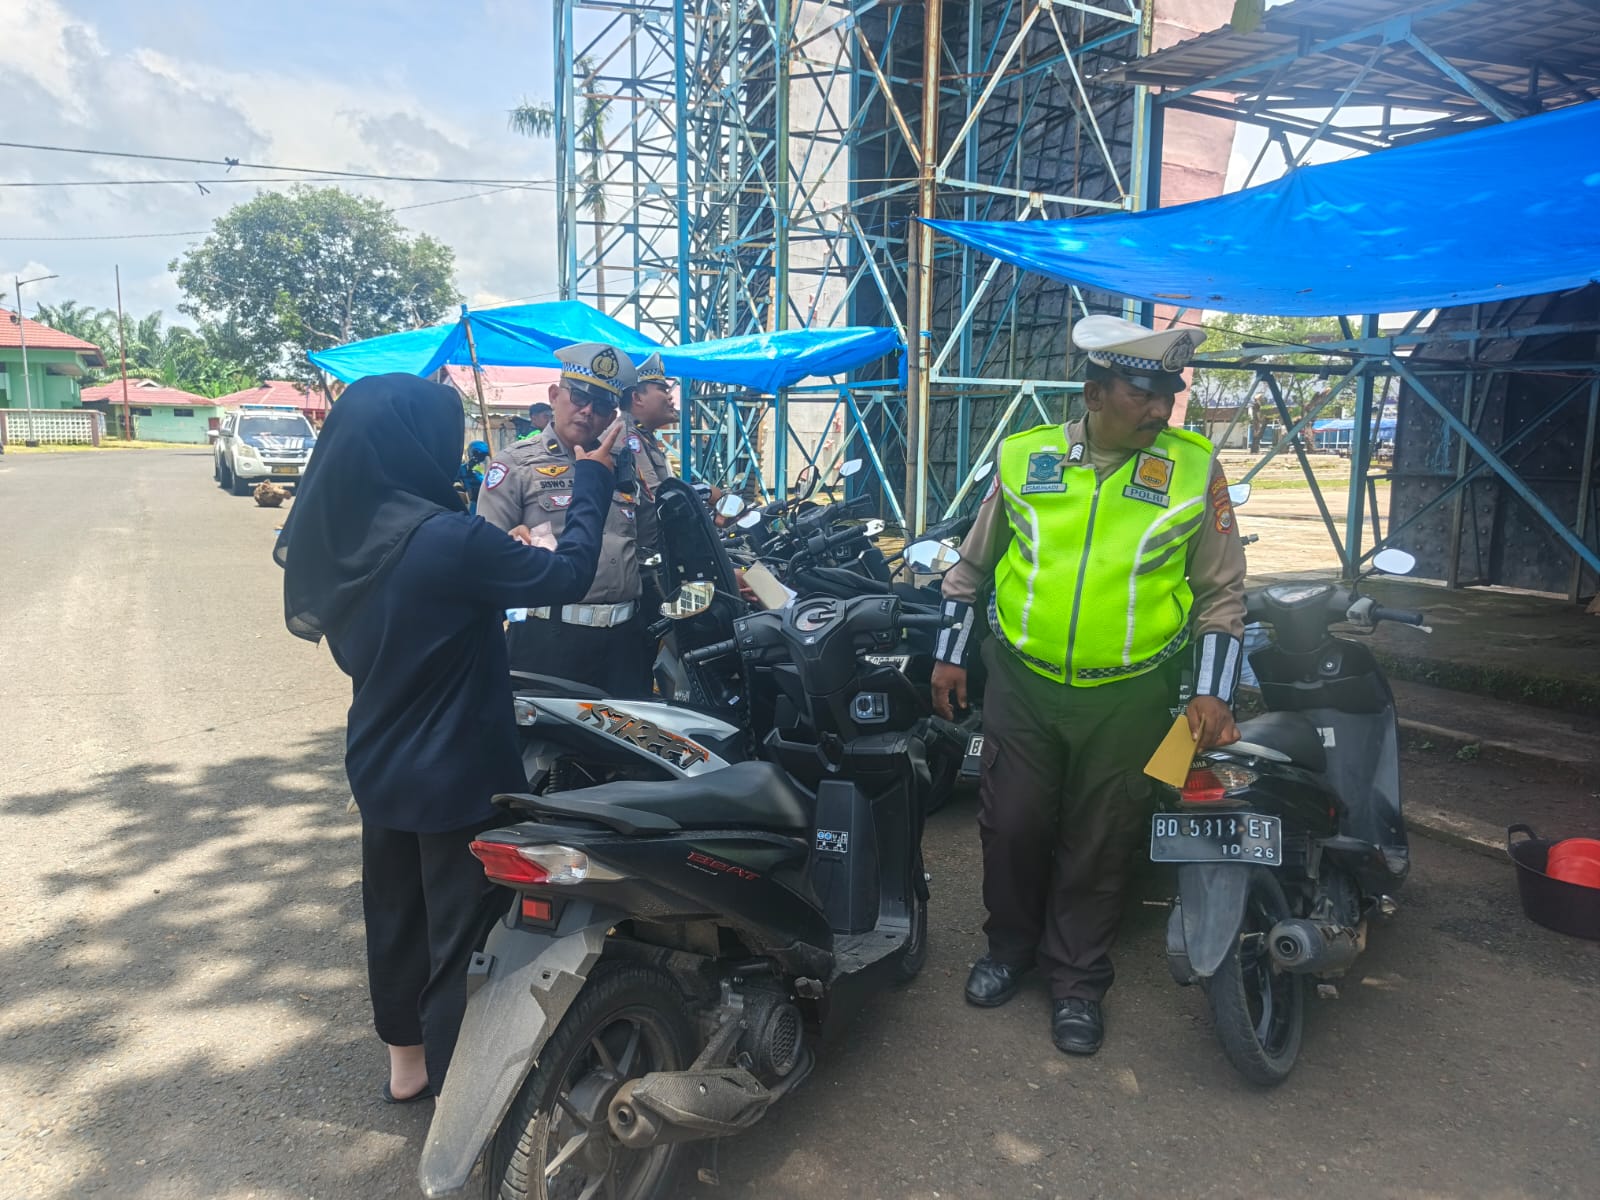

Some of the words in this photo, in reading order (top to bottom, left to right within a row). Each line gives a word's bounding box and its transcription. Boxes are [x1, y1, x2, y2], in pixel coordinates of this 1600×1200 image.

[540, 480, 565, 489] SISWO
[1130, 488, 1163, 502] POLRI
[1156, 818, 1179, 837] BD
[1249, 819, 1272, 839] ET
